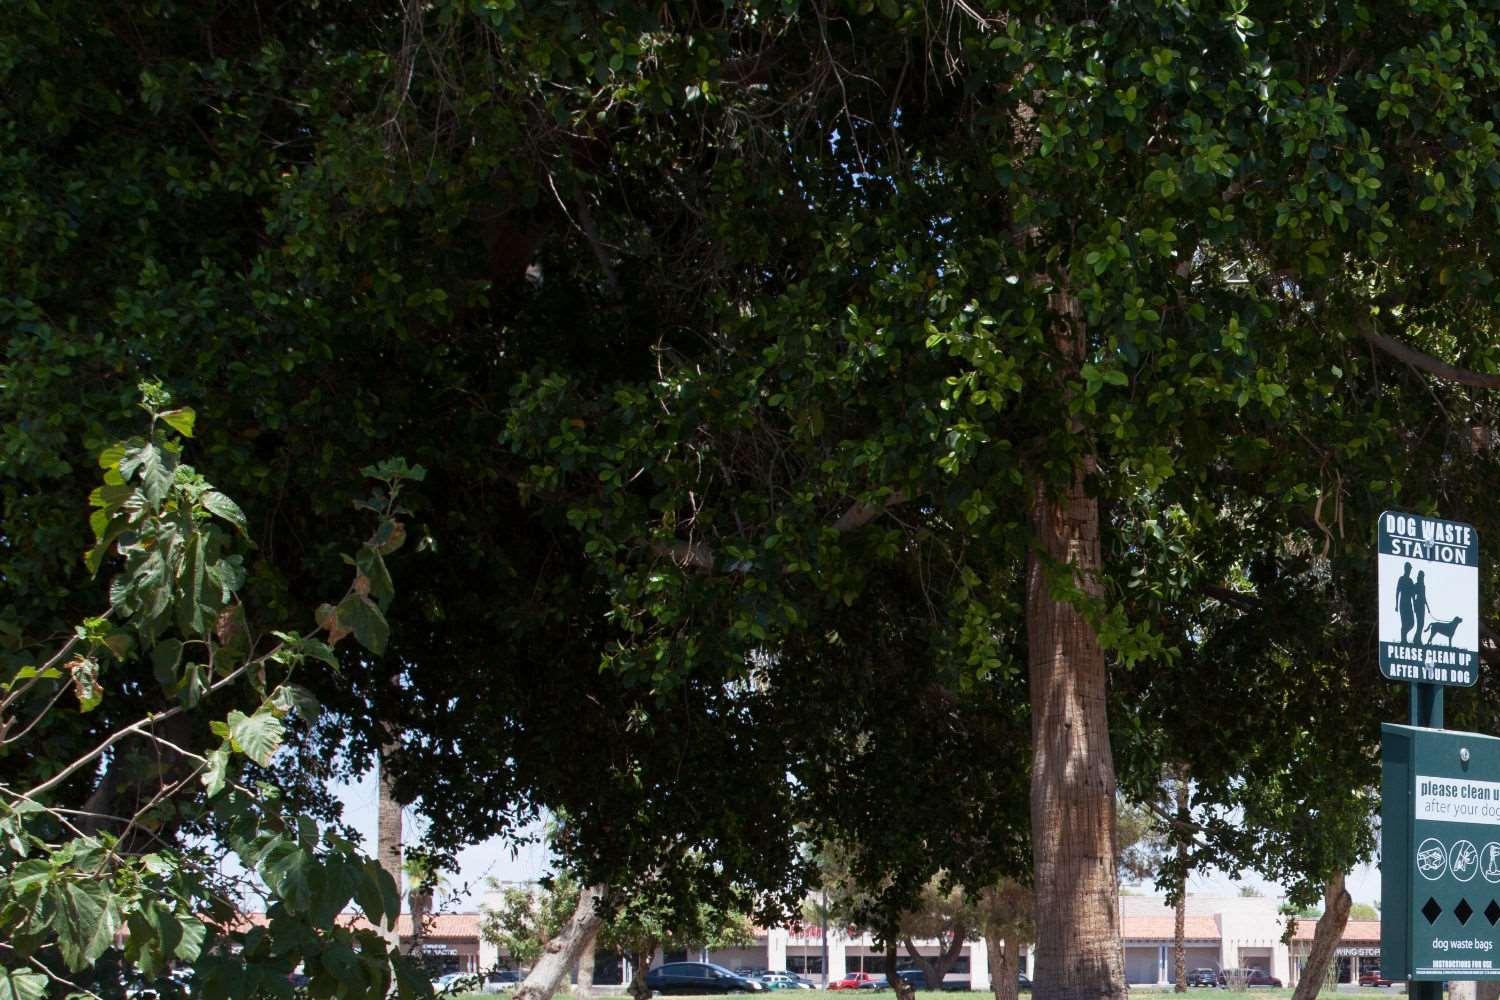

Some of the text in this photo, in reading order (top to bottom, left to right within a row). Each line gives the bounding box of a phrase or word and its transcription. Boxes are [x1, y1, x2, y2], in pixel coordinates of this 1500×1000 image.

[1386, 515, 1471, 545] DOG WASTE
[1391, 539, 1467, 565] STATION
[1387, 644, 1472, 667] PLEASE CLEAN UP
[1389, 663, 1470, 684] AFTER YOUR DOG
[1421, 781, 1458, 797] please
[1461, 784, 1490, 800] clean
[1424, 799, 1450, 813] after
[1454, 804, 1478, 817] your
[1432, 937, 1493, 951] dog waste bags
[1432, 960, 1492, 969] INSTRUCTIONS FOR USE
